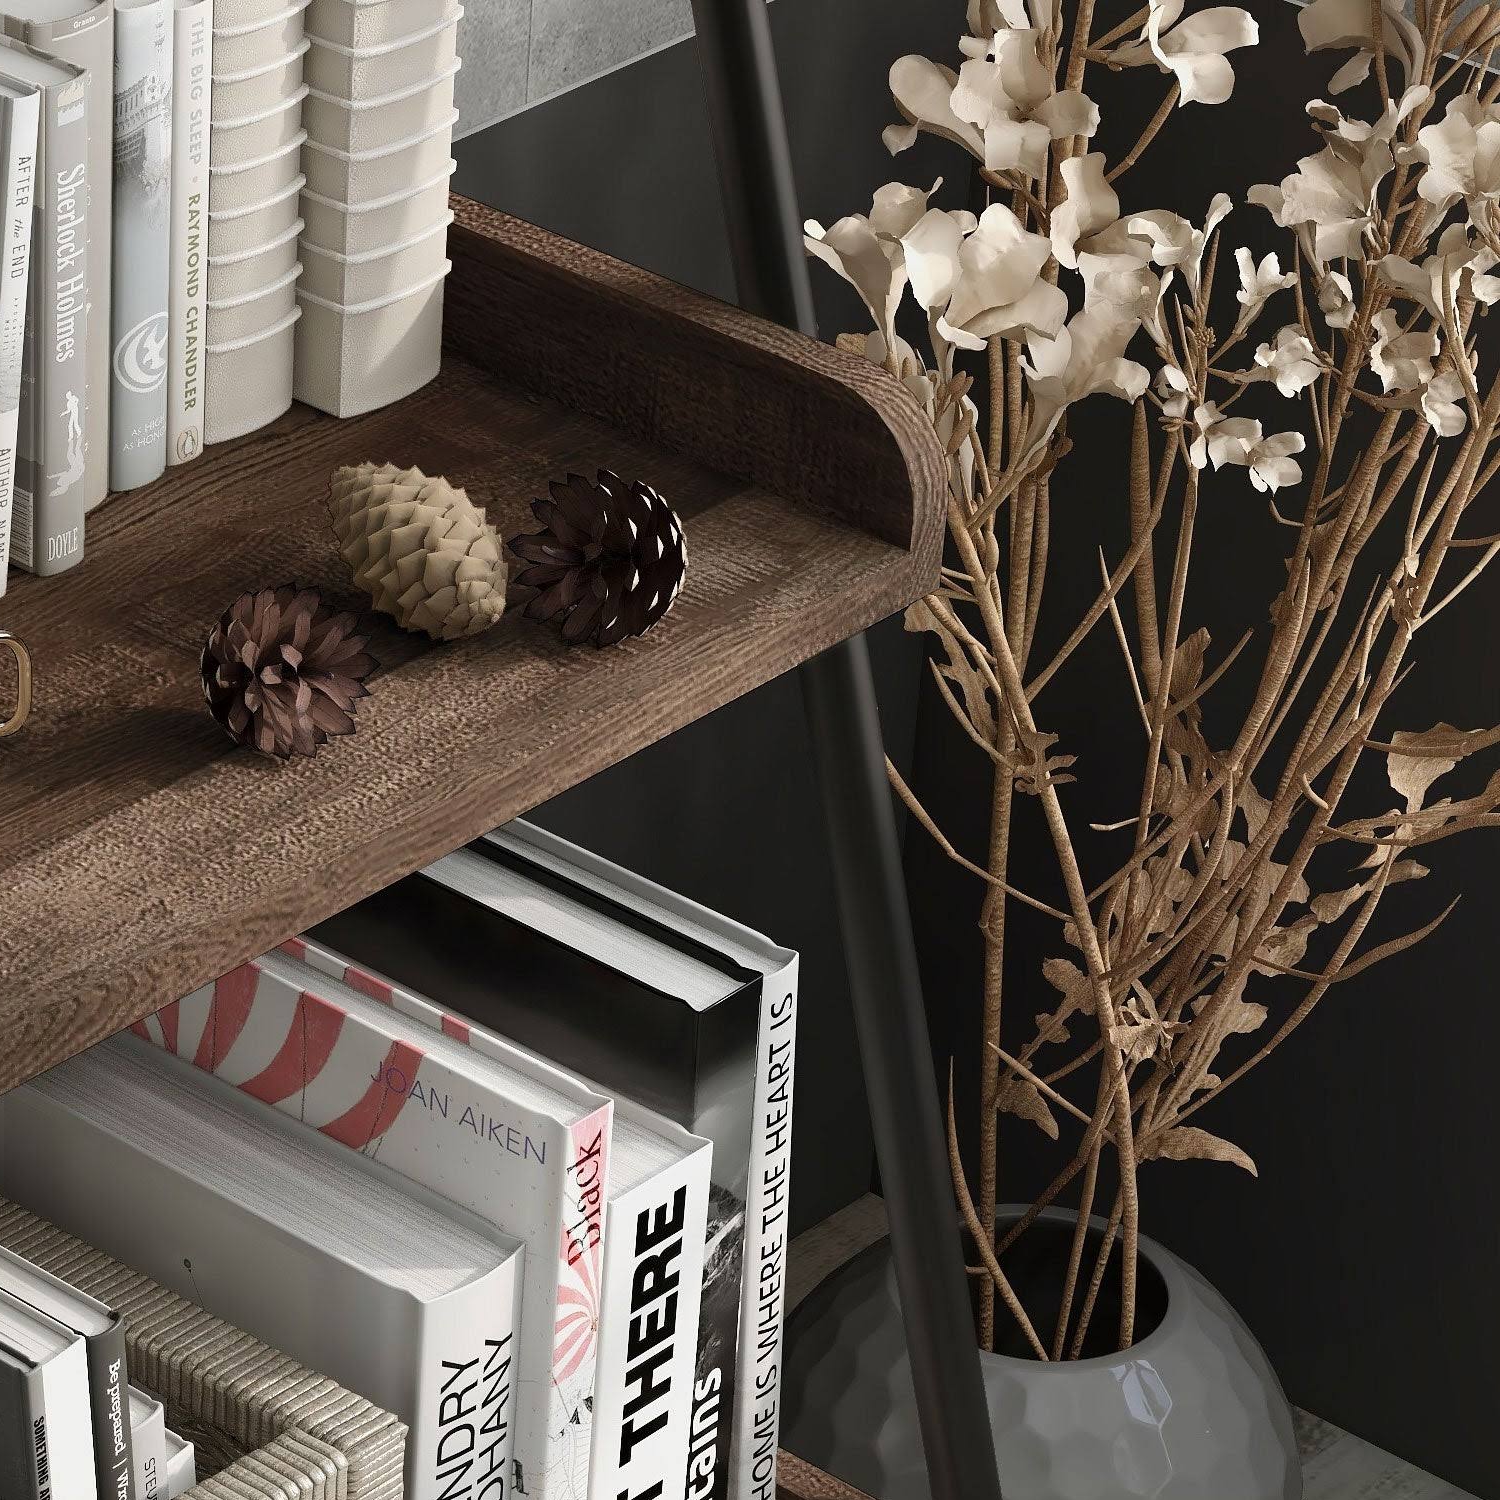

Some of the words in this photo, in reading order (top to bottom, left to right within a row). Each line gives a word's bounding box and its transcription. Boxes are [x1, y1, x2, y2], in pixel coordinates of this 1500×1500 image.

[191, 17, 204, 58] THE
[190, 64, 203, 106] BIG
[189, 111, 203, 167] SLEEP
[15, 156, 32, 208] AFTER
[56, 163, 85, 271] Sherlock
[10, 245, 26, 279] END
[13, 218, 30, 239] the
[187, 193, 201, 298] RAYMOND
[56, 262, 84, 363] Holmes
[184, 306, 198, 412] CHANDLER
[48, 527, 78, 562] DOYLE
[769, 992, 793, 1031] IS
[370, 1060, 449, 1119] JOAN
[458, 1106, 546, 1165] AIKEN
[765, 1039, 792, 1157] HEART
[566, 1129, 602, 1267] Black
[761, 1157, 787, 1235] THE
[618, 1183, 688, 1469] THERE
[756, 1232, 783, 1364] WHERE
[108, 1358, 121, 1384] Be
[755, 1364, 778, 1401] IS
[34, 1415, 49, 1485] SOMETHING
[107, 1384, 126, 1456] prepared
